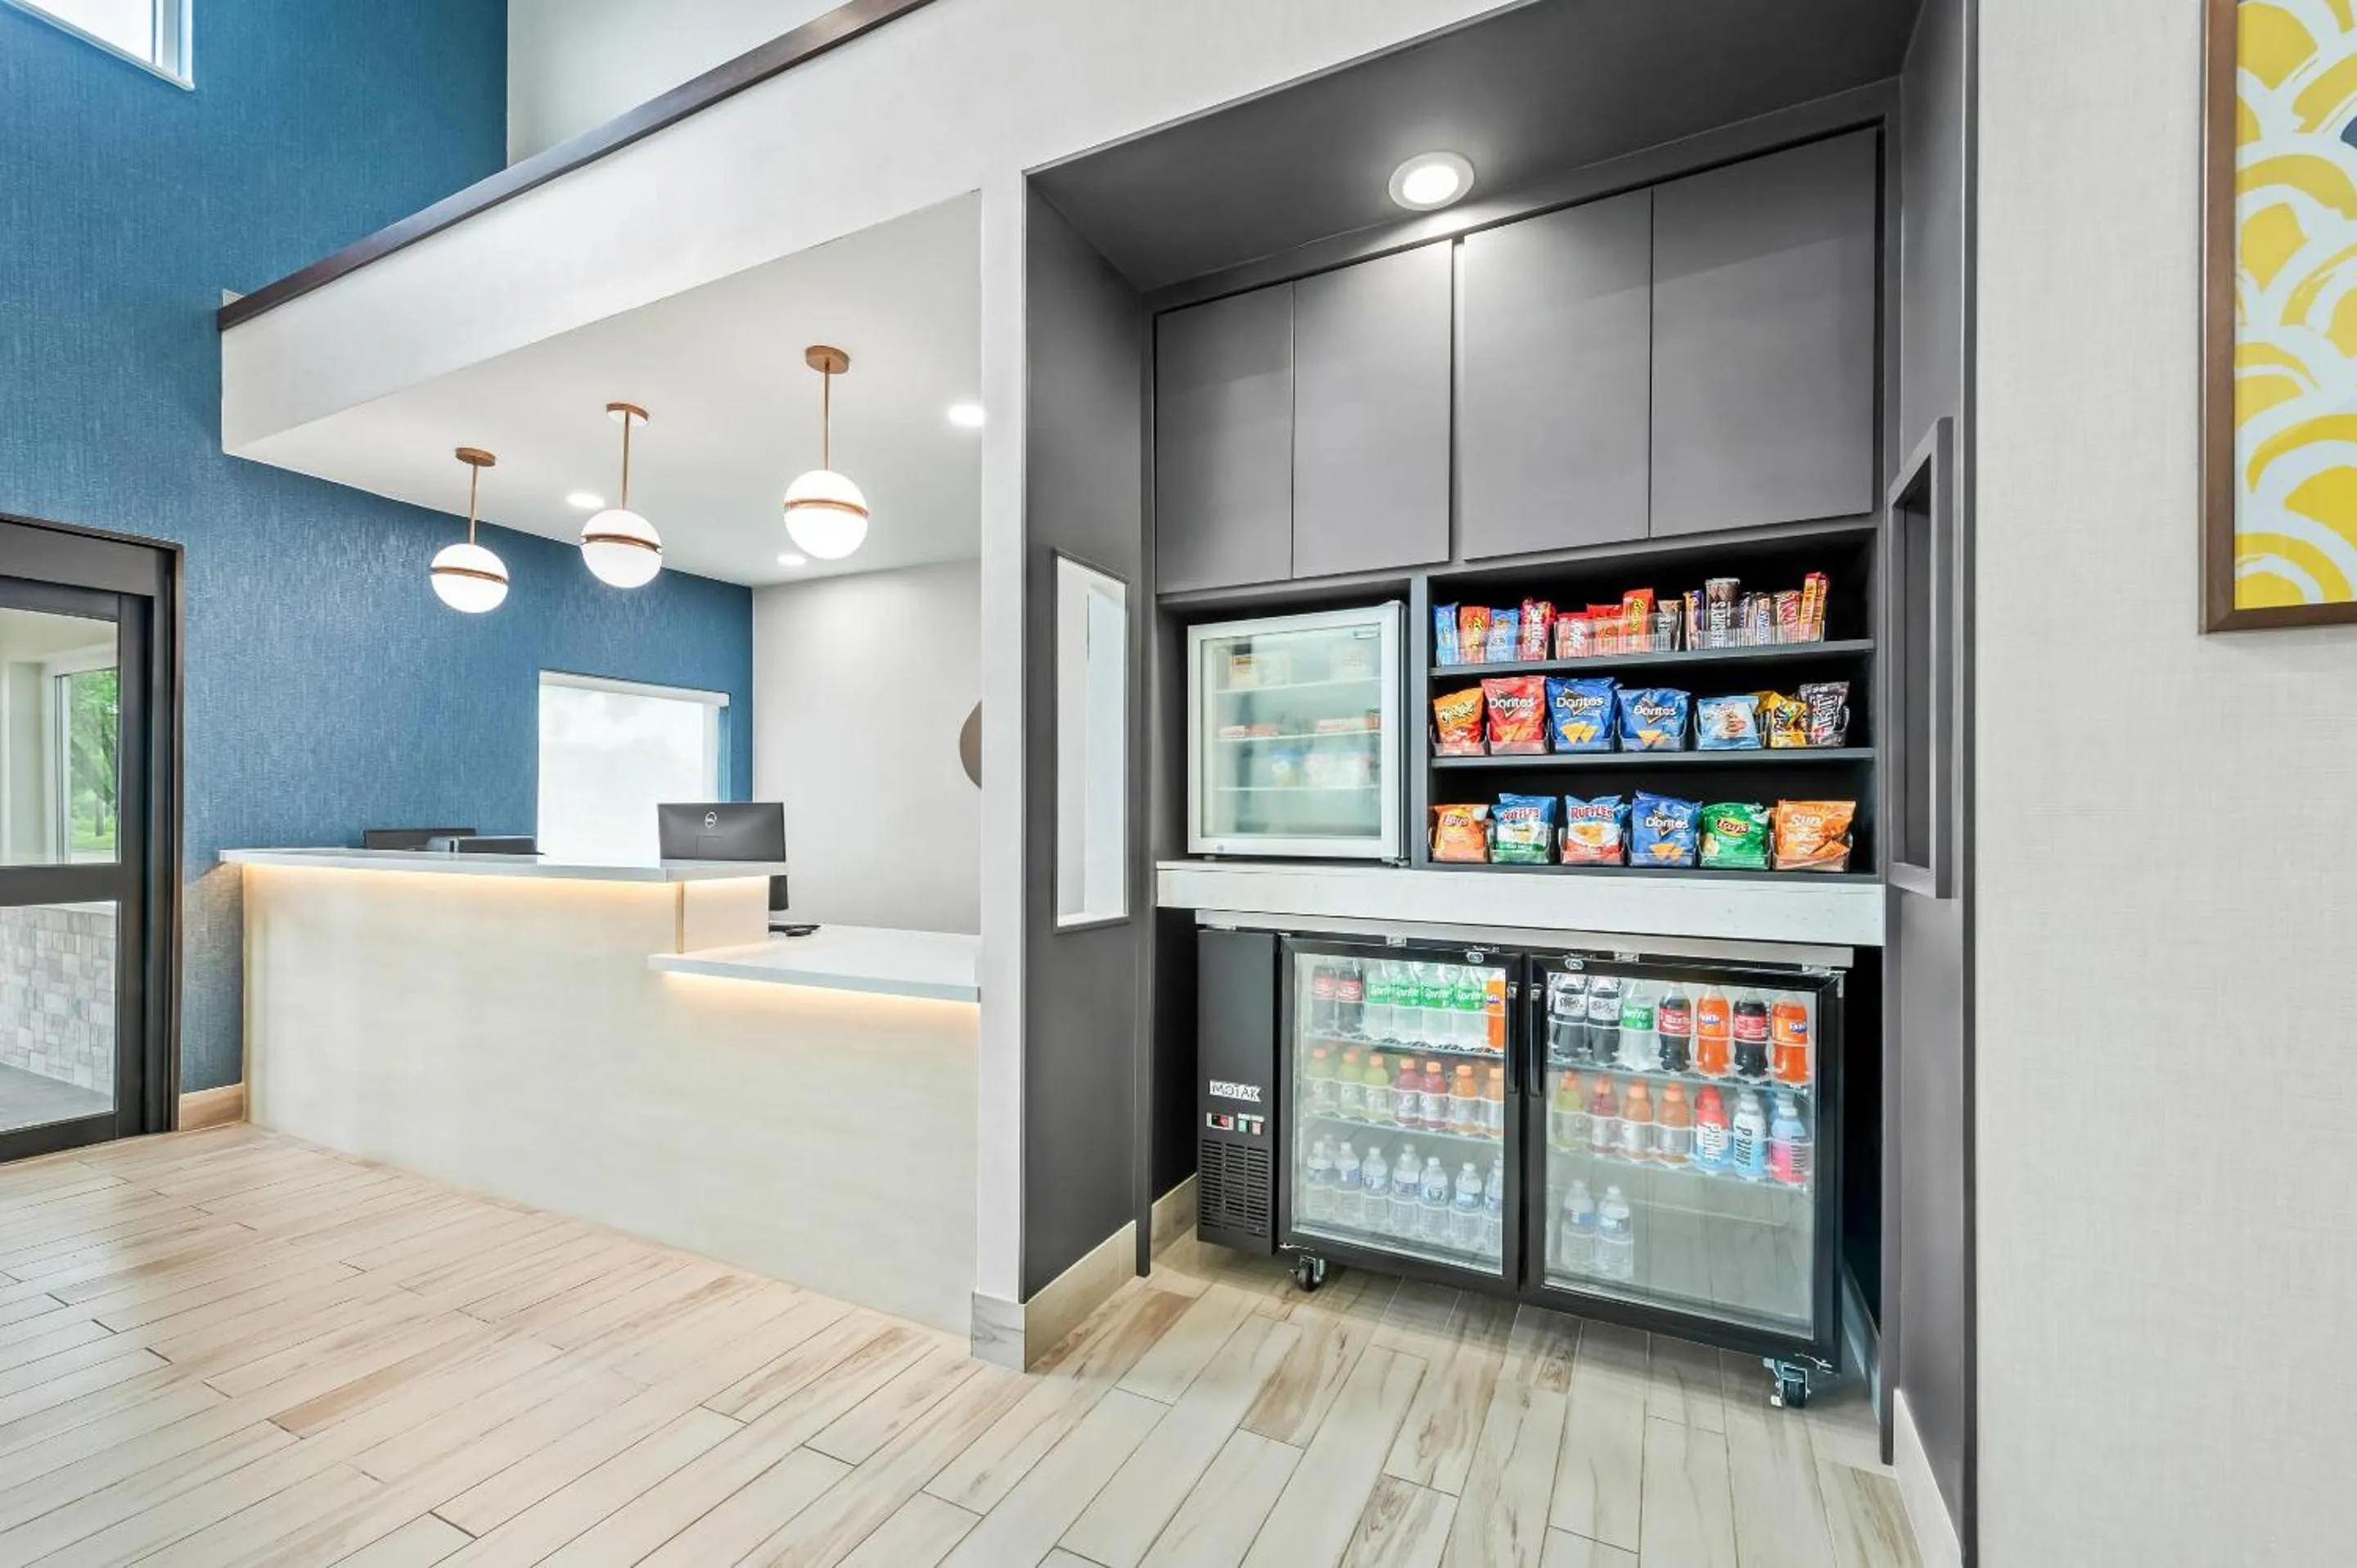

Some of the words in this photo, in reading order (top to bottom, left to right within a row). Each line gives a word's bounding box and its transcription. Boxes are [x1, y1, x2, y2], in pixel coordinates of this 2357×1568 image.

[1489, 696, 1535, 708] Doritos
[1557, 696, 1604, 708] Doritos
[1634, 705, 1676, 716] Doritos
[1646, 817, 1688, 829] Doritos
